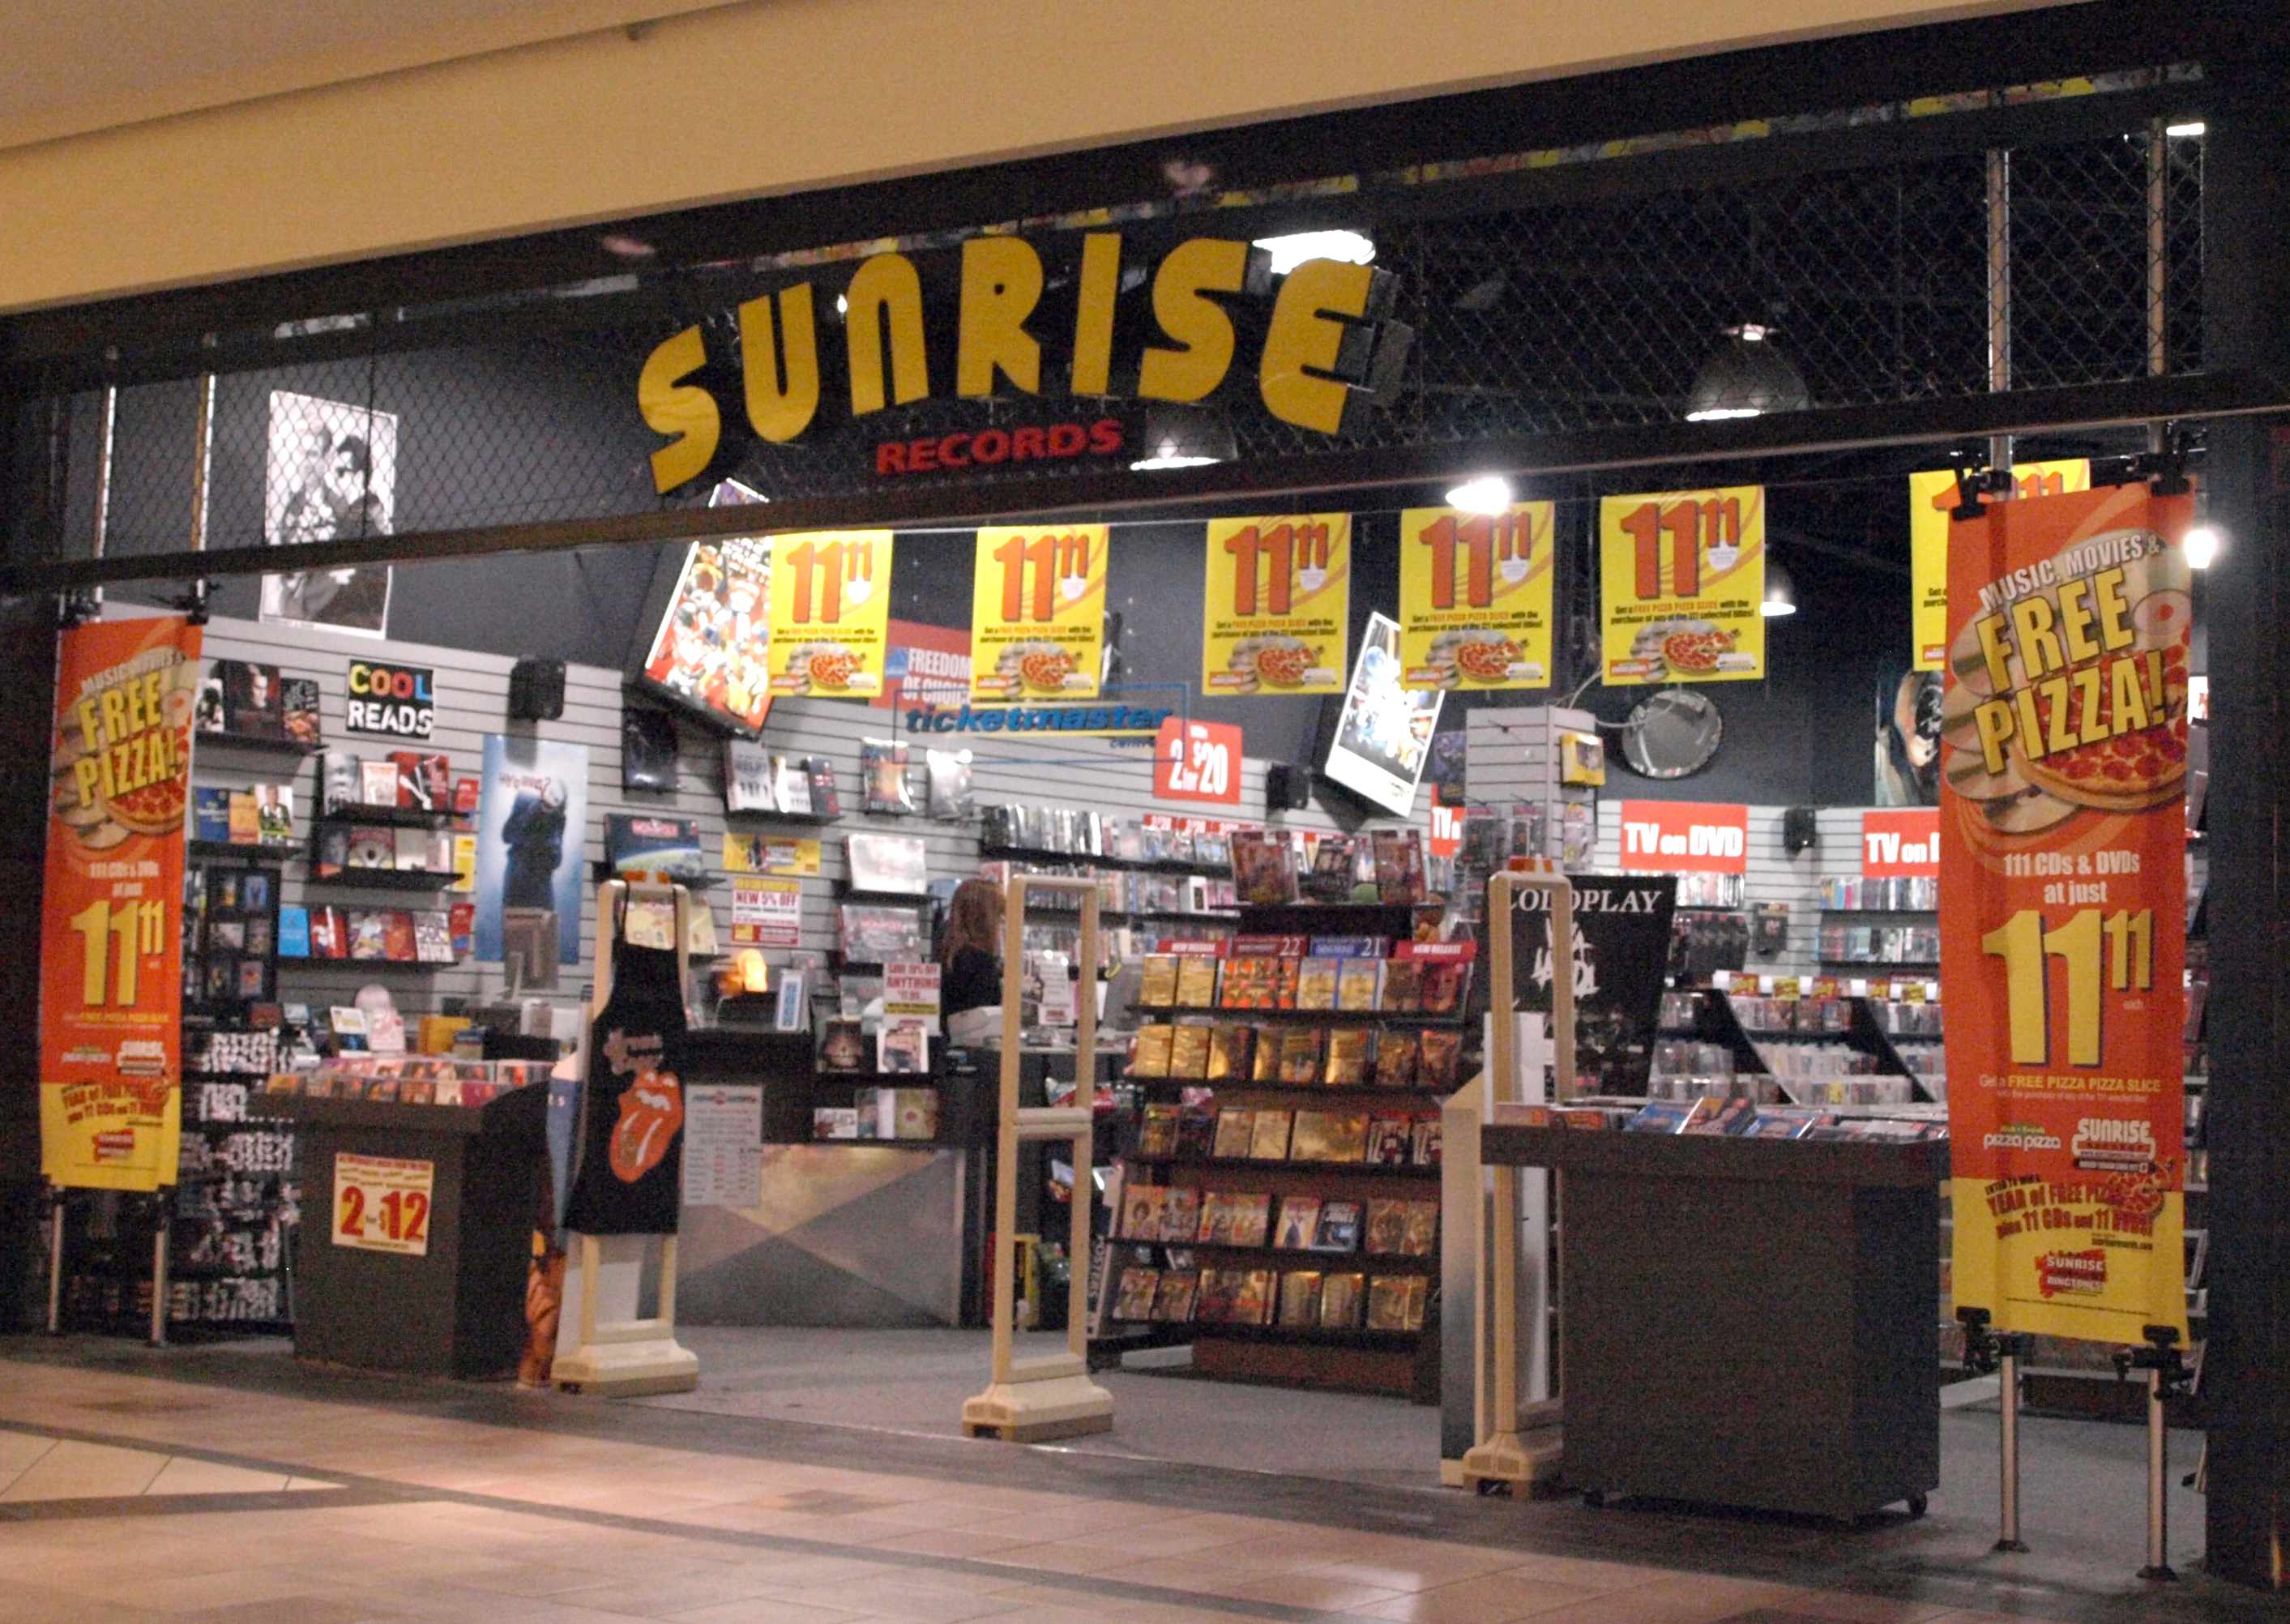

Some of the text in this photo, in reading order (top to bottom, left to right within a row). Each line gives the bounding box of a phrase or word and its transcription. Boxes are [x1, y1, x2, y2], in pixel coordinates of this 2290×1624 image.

[639, 233, 1373, 494] SUNRISE
[877, 418, 1122, 475] RECORDS
[2063, 534, 2143, 576] MOVIES
[2148, 534, 2160, 555] &
[1924, 599, 1946, 608] purch
[1976, 567, 2134, 694] FREE
[908, 647, 971, 679] FREEDOM
[349, 664, 433, 702] COOL
[903, 674, 971, 706] OF CHOIC
[79, 671, 161, 751] FREE
[348, 700, 433, 735] READS
[906, 704, 1173, 733] ticketmaster
[1974, 650, 2166, 776] PIZZA!
[74, 729, 177, 807] PIZZA!
[1168, 738, 1183, 790] 2
[1193, 741, 1228, 795] $20
[1433, 806, 1452, 840] TV
[1624, 822, 1743, 857] TV on DVD
[1865, 832, 1900, 863] TV
[1902, 843, 1927, 863] on
[2003, 851, 2140, 877] 111 CDs & DVDs
[1511, 889, 1662, 913] OLPLAY
[2044, 880, 2107, 905] at just
[1280, 937, 1301, 956] 22
[1361, 937, 1380, 956] 21
[2008, 1075, 2044, 1088] FREE
[2047, 1076, 2084, 1090] PIZZA
[2089, 1078, 2124, 1092] PIZZA
[2127, 1079, 2161, 1092] SLICE
[1984, 1134, 2061, 1152] pizza pizza
[2075, 1118, 2152, 1146] SUNRISE
[341, 1186, 365, 1237] 2
[2047, 1257, 2104, 1271] SUNRISE
